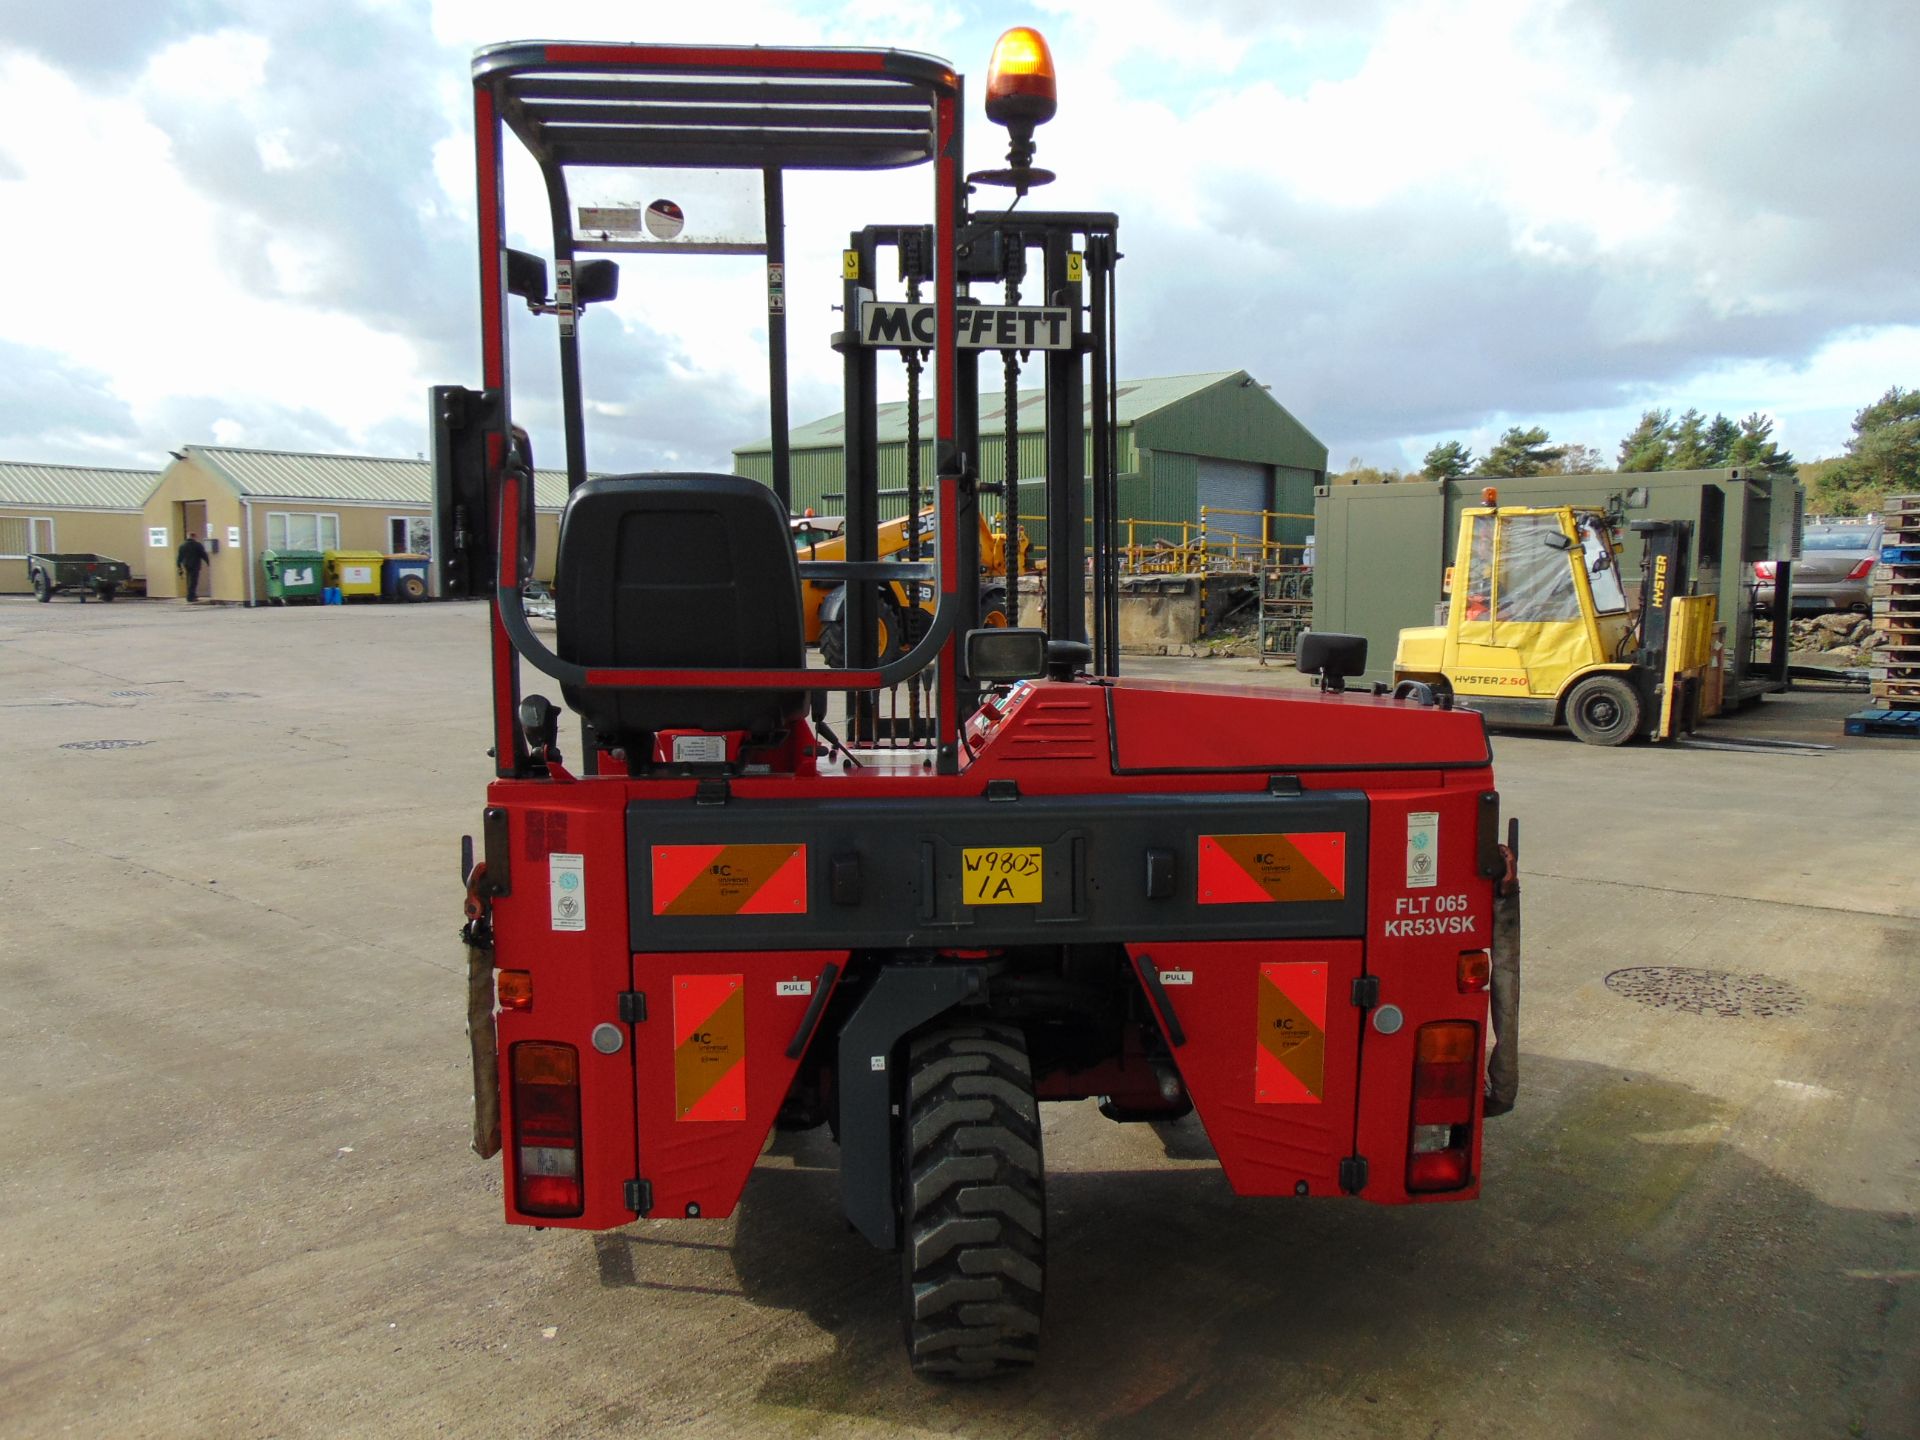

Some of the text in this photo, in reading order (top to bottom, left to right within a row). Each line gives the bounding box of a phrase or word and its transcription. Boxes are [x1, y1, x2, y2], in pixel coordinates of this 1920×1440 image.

[868, 307, 1067, 345] MOFFETT
[1652, 555, 1667, 608] HYSTER
[1454, 675, 1498, 685] HYSTER
[964, 851, 1041, 876] W9805
[1395, 895, 1468, 915] FLT 065
[1385, 916, 1476, 937] KR53VSK
[783, 983, 805, 992] PULL
